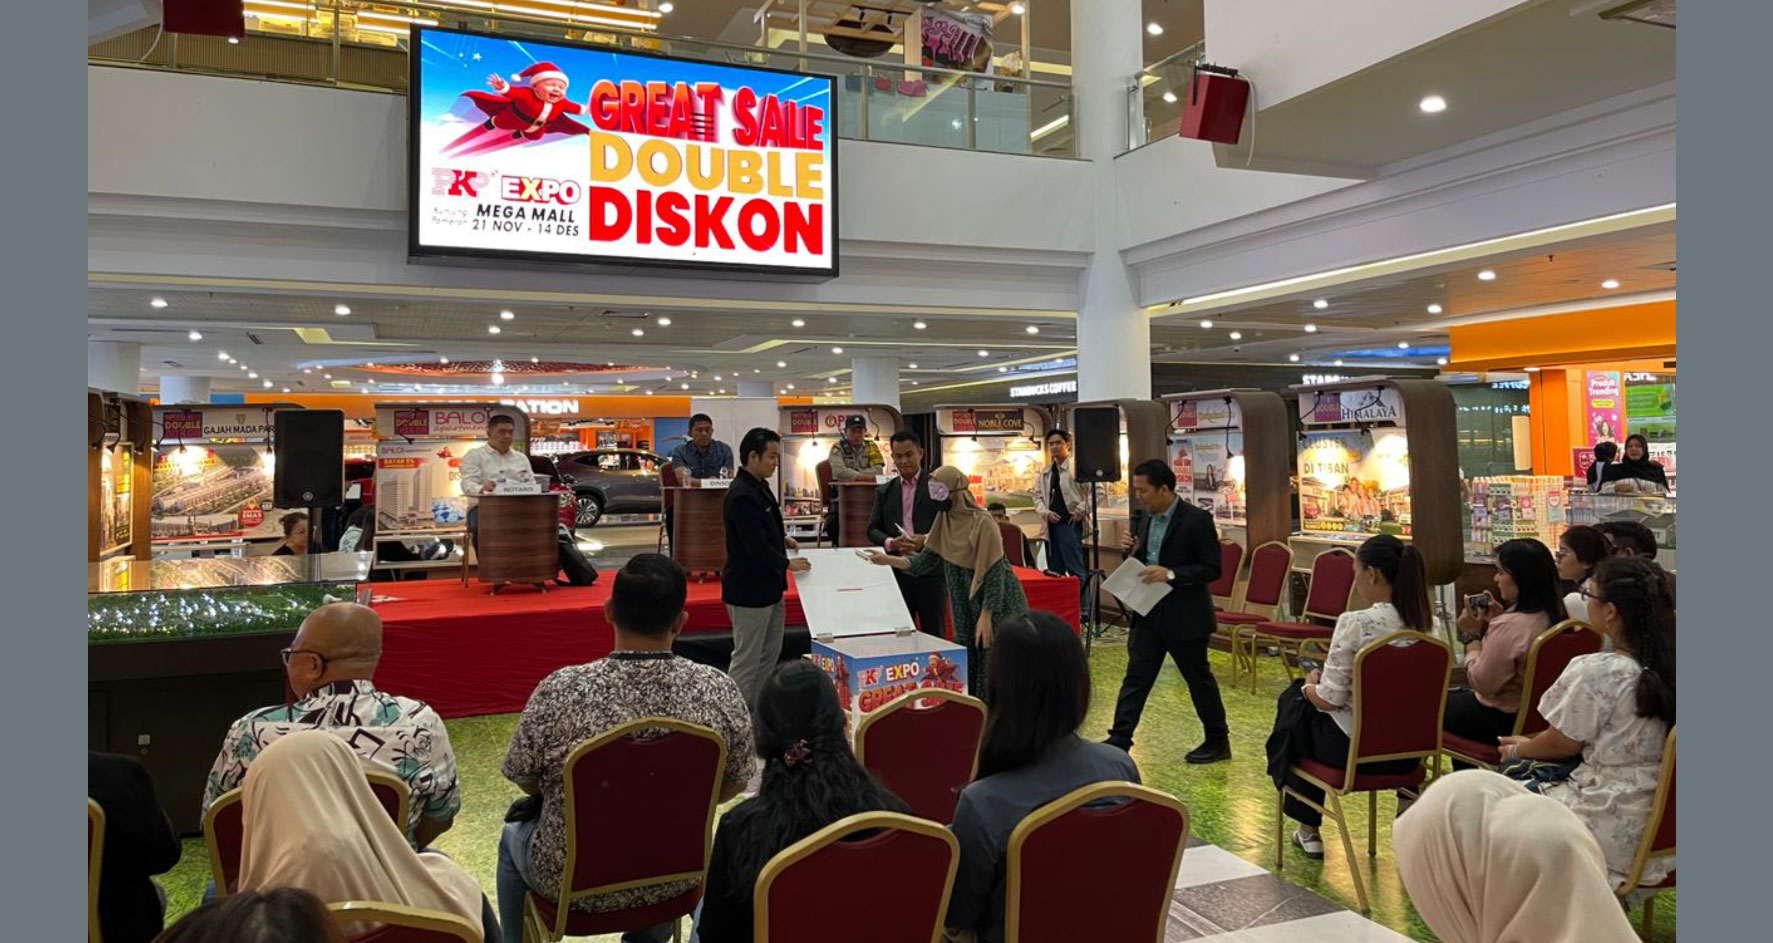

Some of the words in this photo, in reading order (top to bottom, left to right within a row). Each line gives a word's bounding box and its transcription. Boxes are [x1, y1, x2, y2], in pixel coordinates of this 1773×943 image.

[589, 79, 724, 142] GREAT
[732, 85, 824, 150] SALE
[589, 130, 824, 199] DOUBLE
[501, 175, 581, 205] EXPO
[477, 204, 526, 219] MEGA
[531, 207, 575, 223] MALL
[589, 186, 824, 255] DISKON
[472, 219, 486, 230] 21
[492, 221, 523, 232] NOV
[538, 224, 551, 234] 14
[556, 225, 579, 236] DES
[1010, 384, 1049, 397] STARBUCKS
[1049, 381, 1076, 393] COFFEE
[489, 400, 579, 414] ATION
[1342, 405, 1397, 419] HIMALAYA
[435, 411, 486, 425] BALO
[979, 419, 1001, 429] NOBLE
[1004, 418, 1022, 428] COVE
[203, 426, 232, 435] GAJAH
[233, 426, 257, 434] MADA
[259, 425, 275, 433] PAR
[885, 662, 920, 682] EXPO
